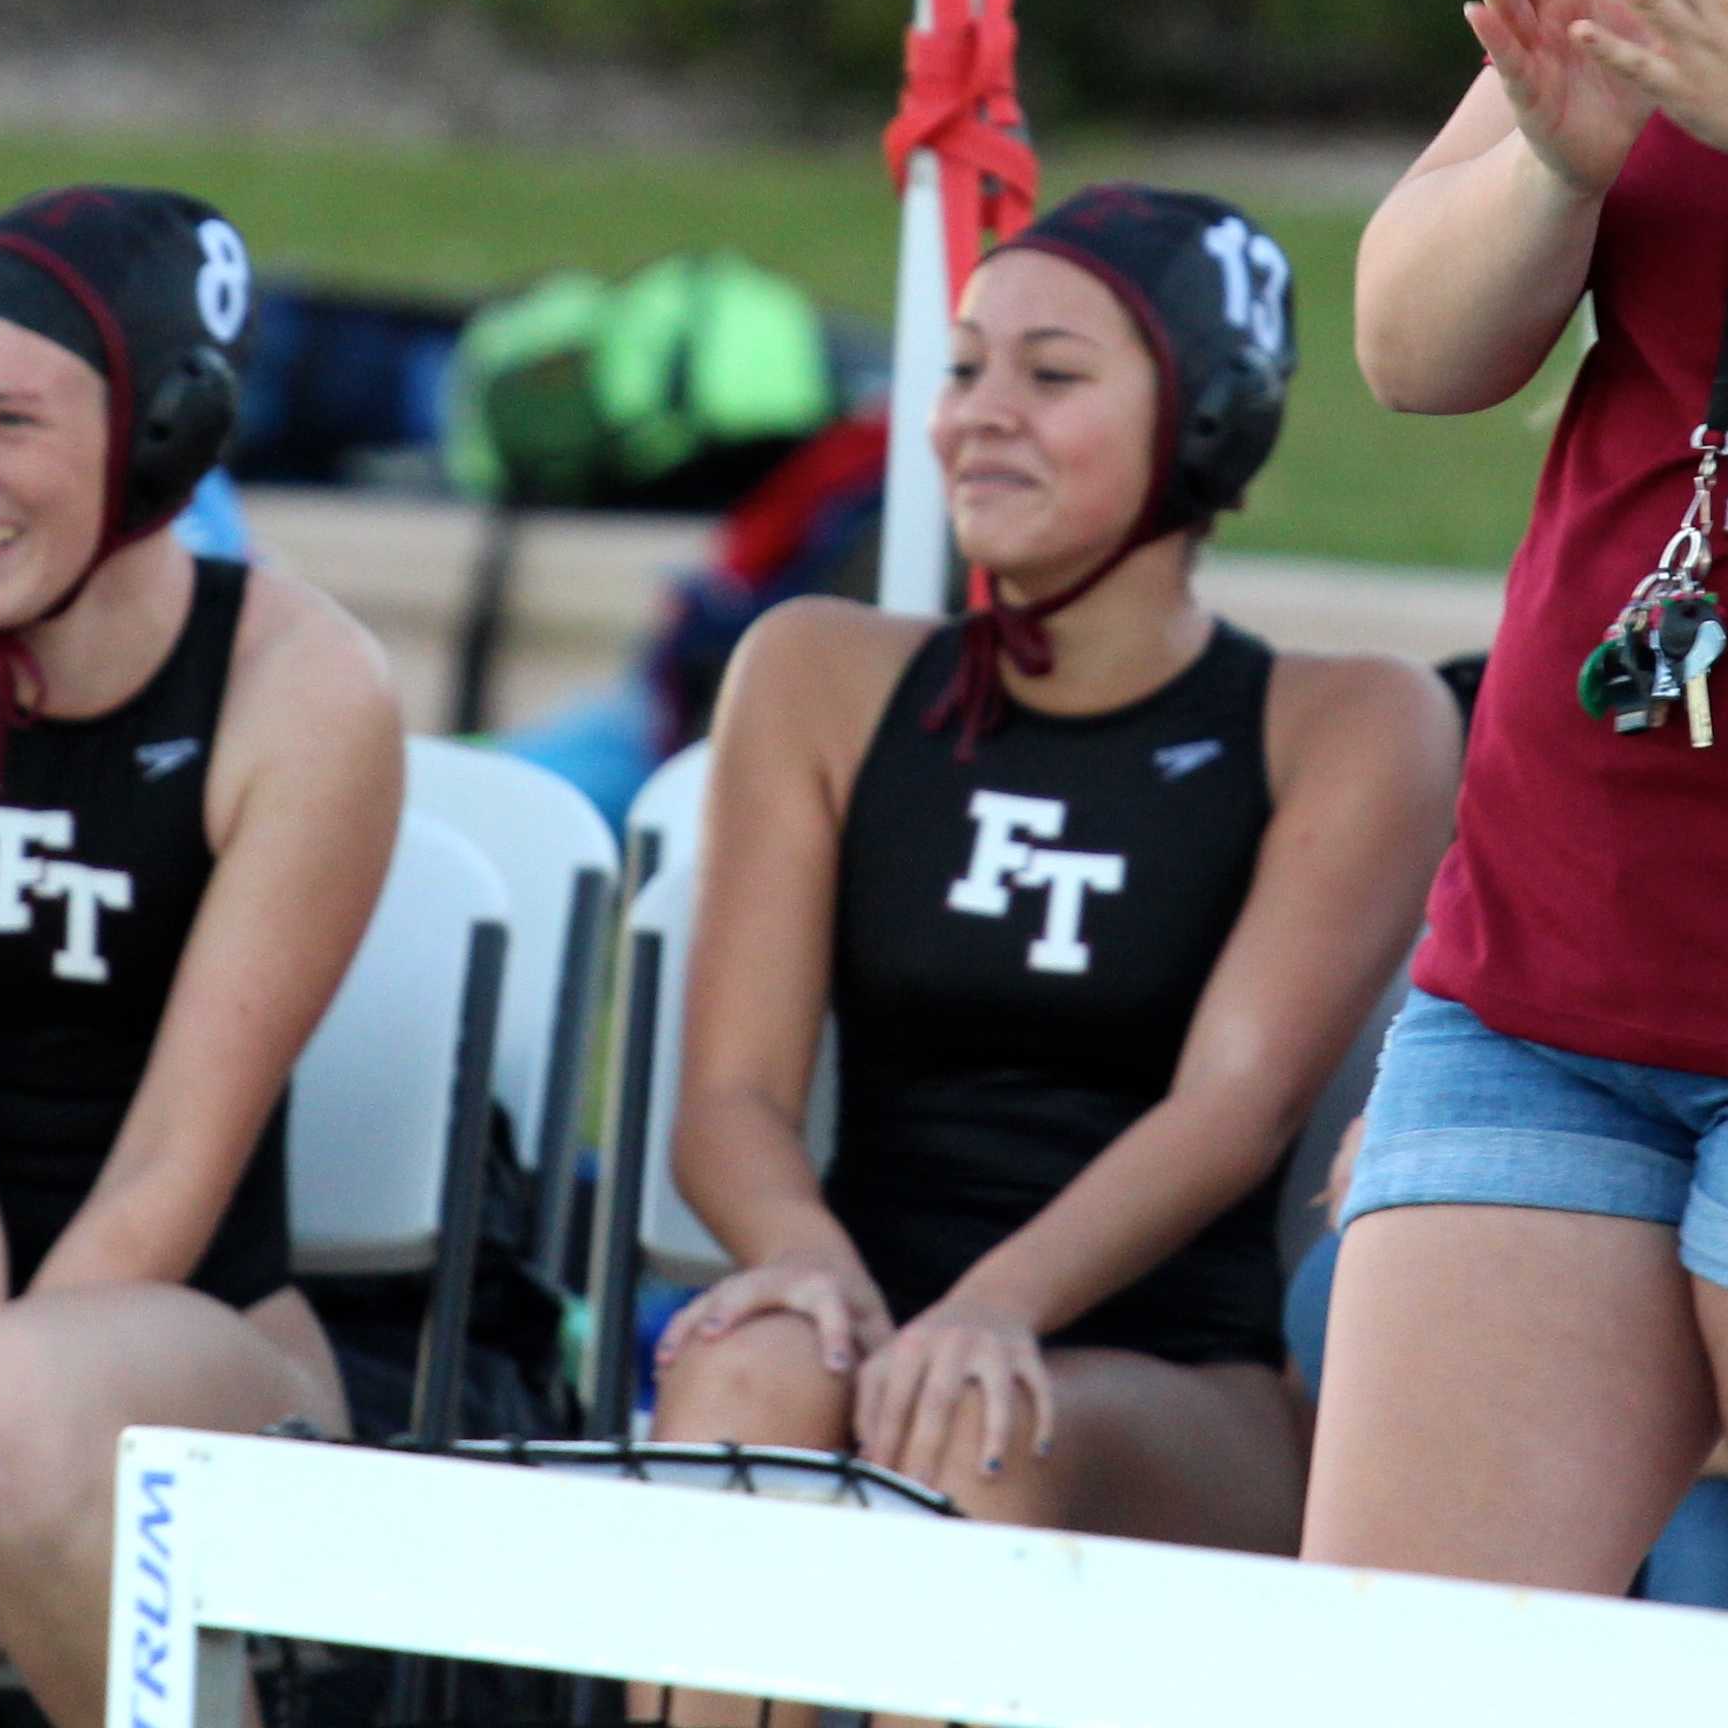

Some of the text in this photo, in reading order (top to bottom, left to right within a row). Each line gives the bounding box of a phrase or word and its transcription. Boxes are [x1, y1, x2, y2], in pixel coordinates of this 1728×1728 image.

[195, 217, 251, 345] 8
[1201, 214, 1289, 353] 13
[945, 788, 1127, 975] FT
